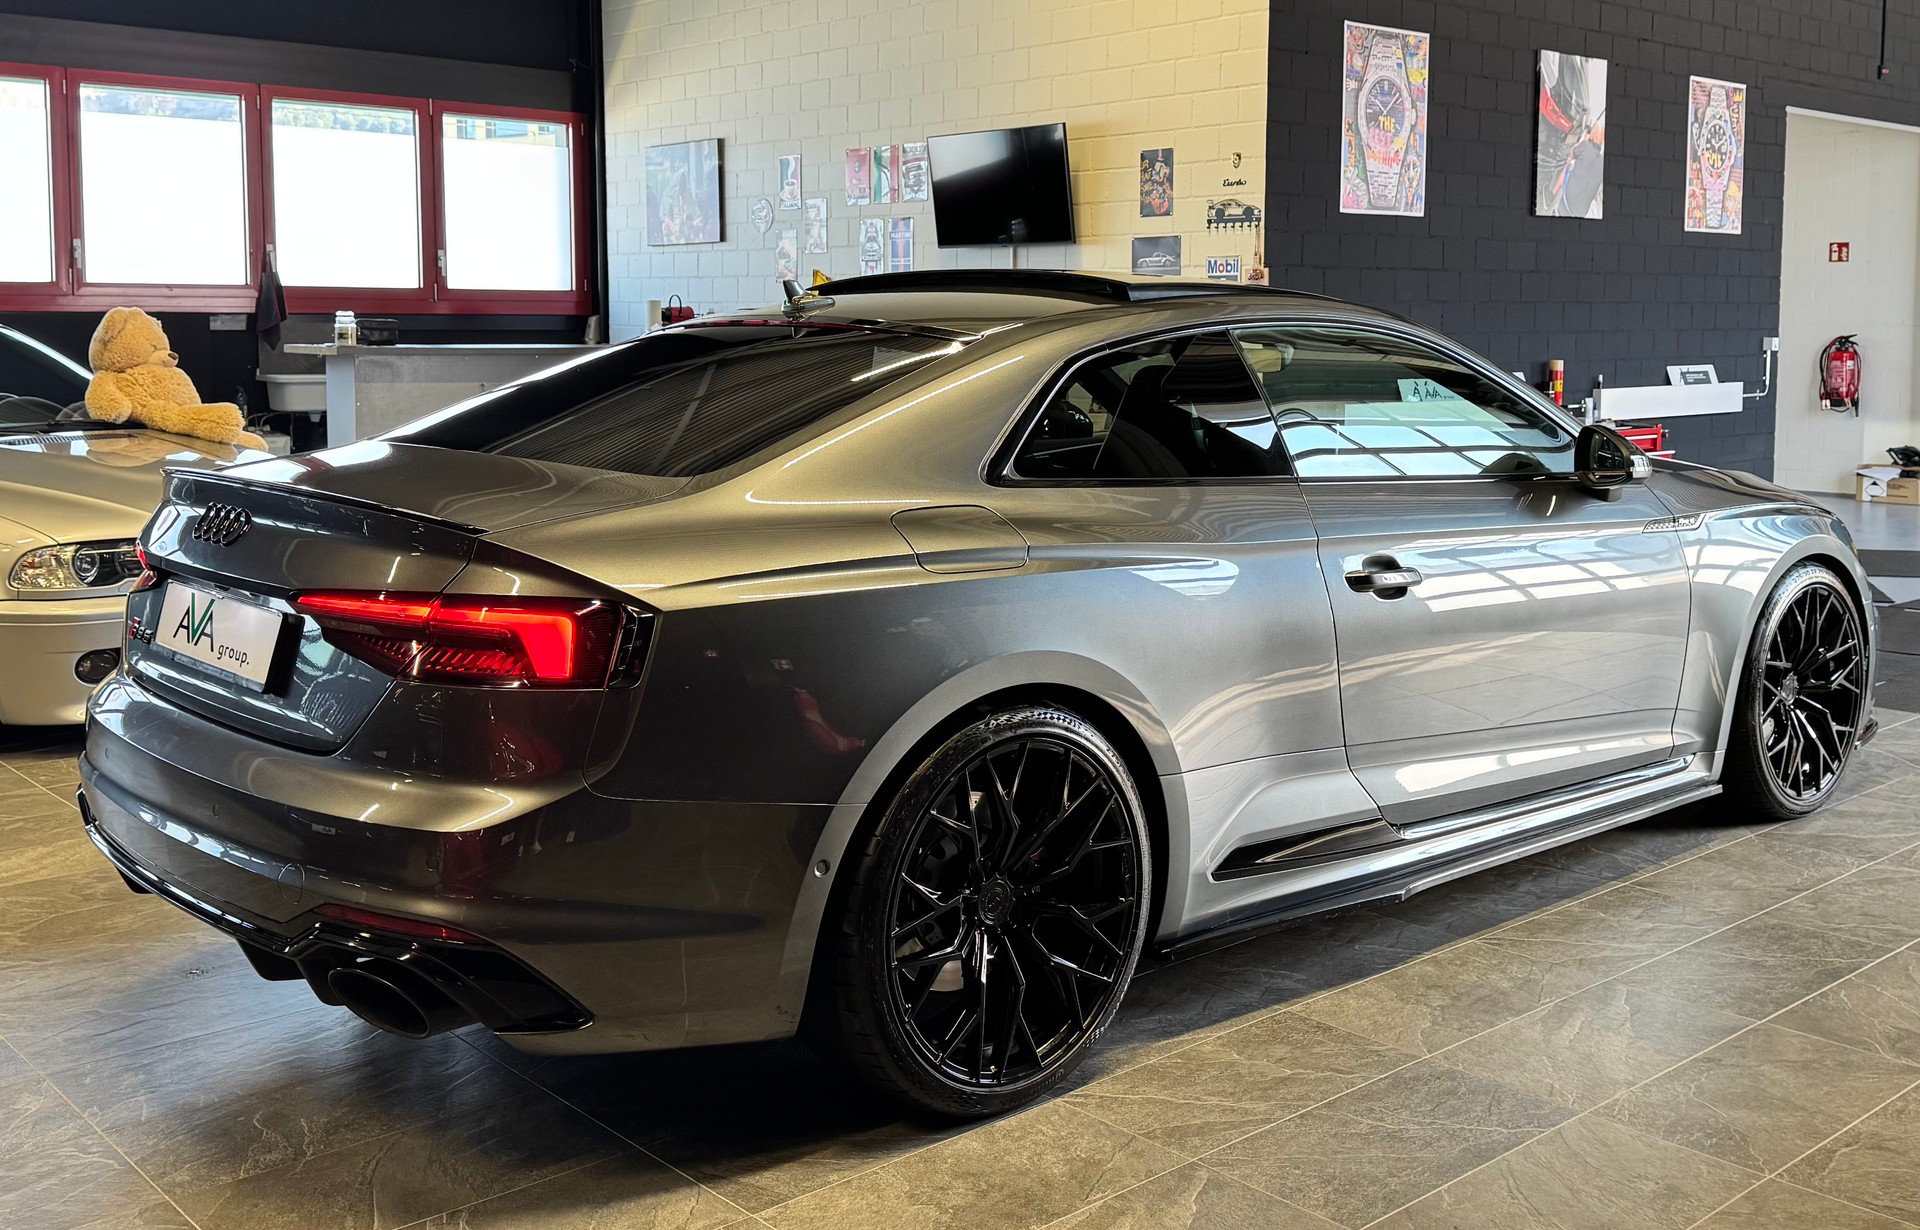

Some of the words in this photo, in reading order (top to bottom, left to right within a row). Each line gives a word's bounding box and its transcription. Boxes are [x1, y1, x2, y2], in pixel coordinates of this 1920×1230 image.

[1379, 116, 1395, 133] THE
[1222, 178, 1247, 187] Turbo
[1208, 259, 1239, 274] Mobil
[173, 592, 216, 652] AVA
